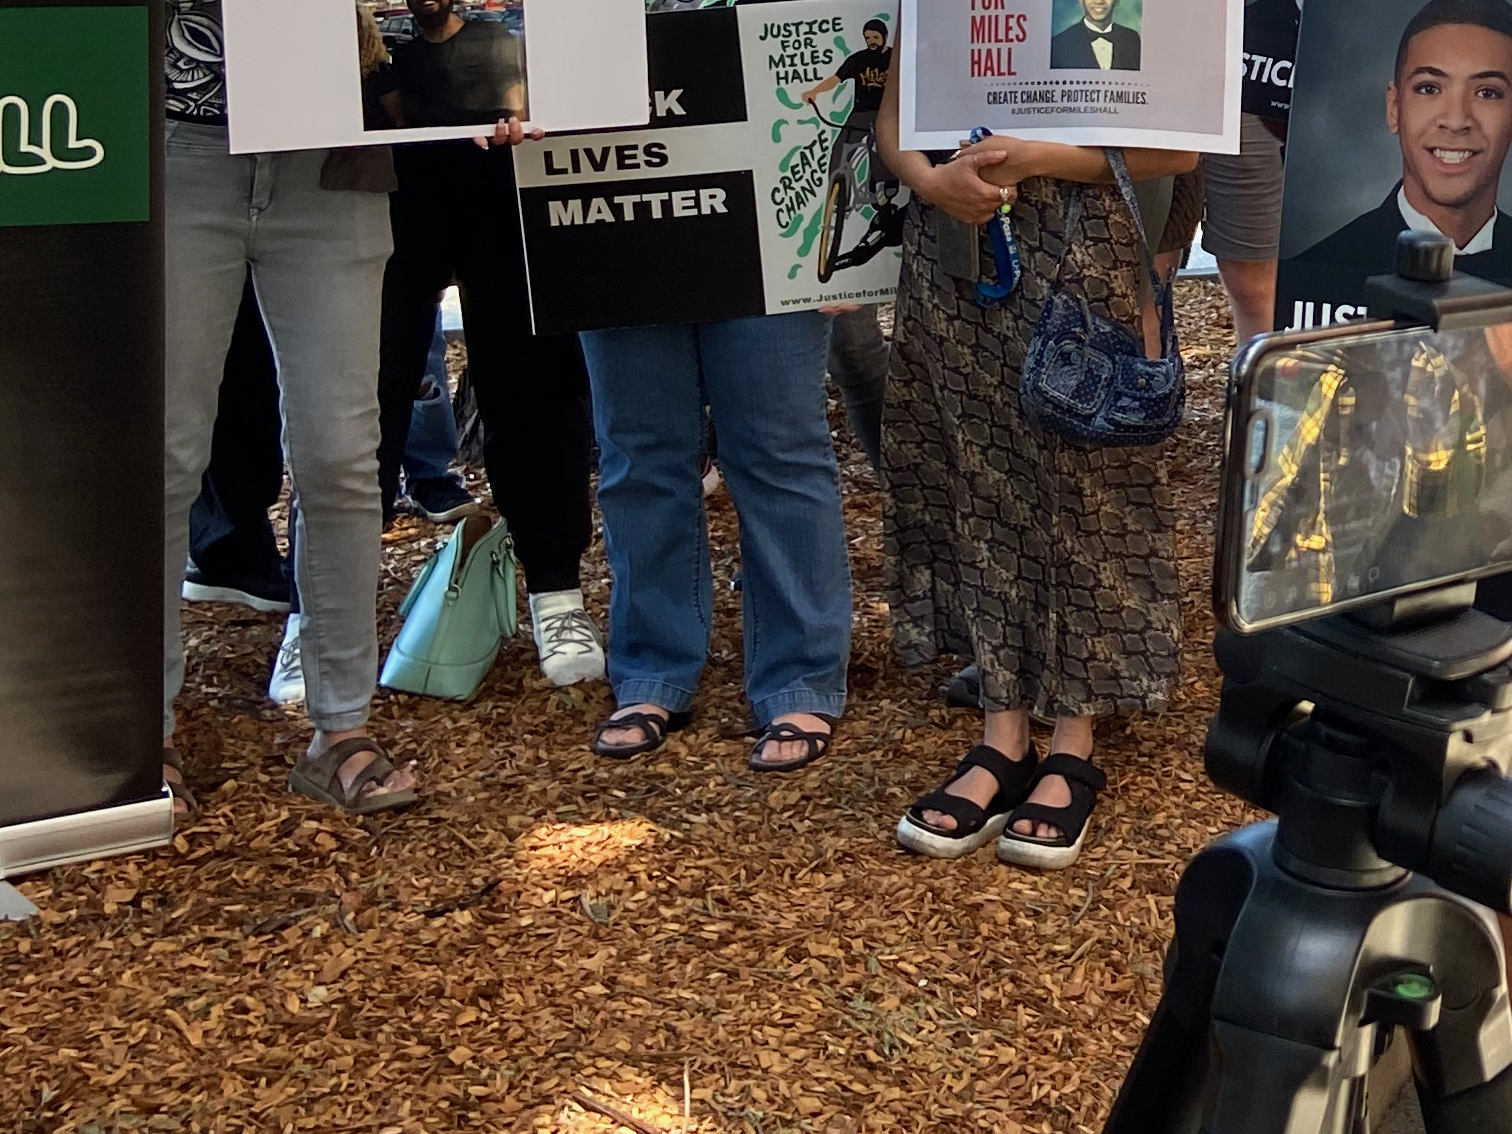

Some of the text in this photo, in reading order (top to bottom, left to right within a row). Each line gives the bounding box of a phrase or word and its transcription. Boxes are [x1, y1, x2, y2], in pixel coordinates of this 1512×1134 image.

[759, 16, 844, 41] JUSTICE
[971, 14, 1027, 44] MILES
[780, 37, 817, 54] FOR
[768, 48, 834, 72] MILES
[970, 48, 1017, 78] HALL
[776, 67, 824, 86] HALL
[987, 90, 1019, 105] CREATE
[1061, 89, 1101, 104] PROTECT
[1011, 105, 1120, 115] #JUSTICEFORMILESHALL
[544, 141, 670, 176] LIVES
[771, 129, 830, 207] CREATE
[775, 153, 829, 229] CHANGE
[548, 186, 729, 227] MATTER
[781, 286, 898, 306] www.JusticeforMil
